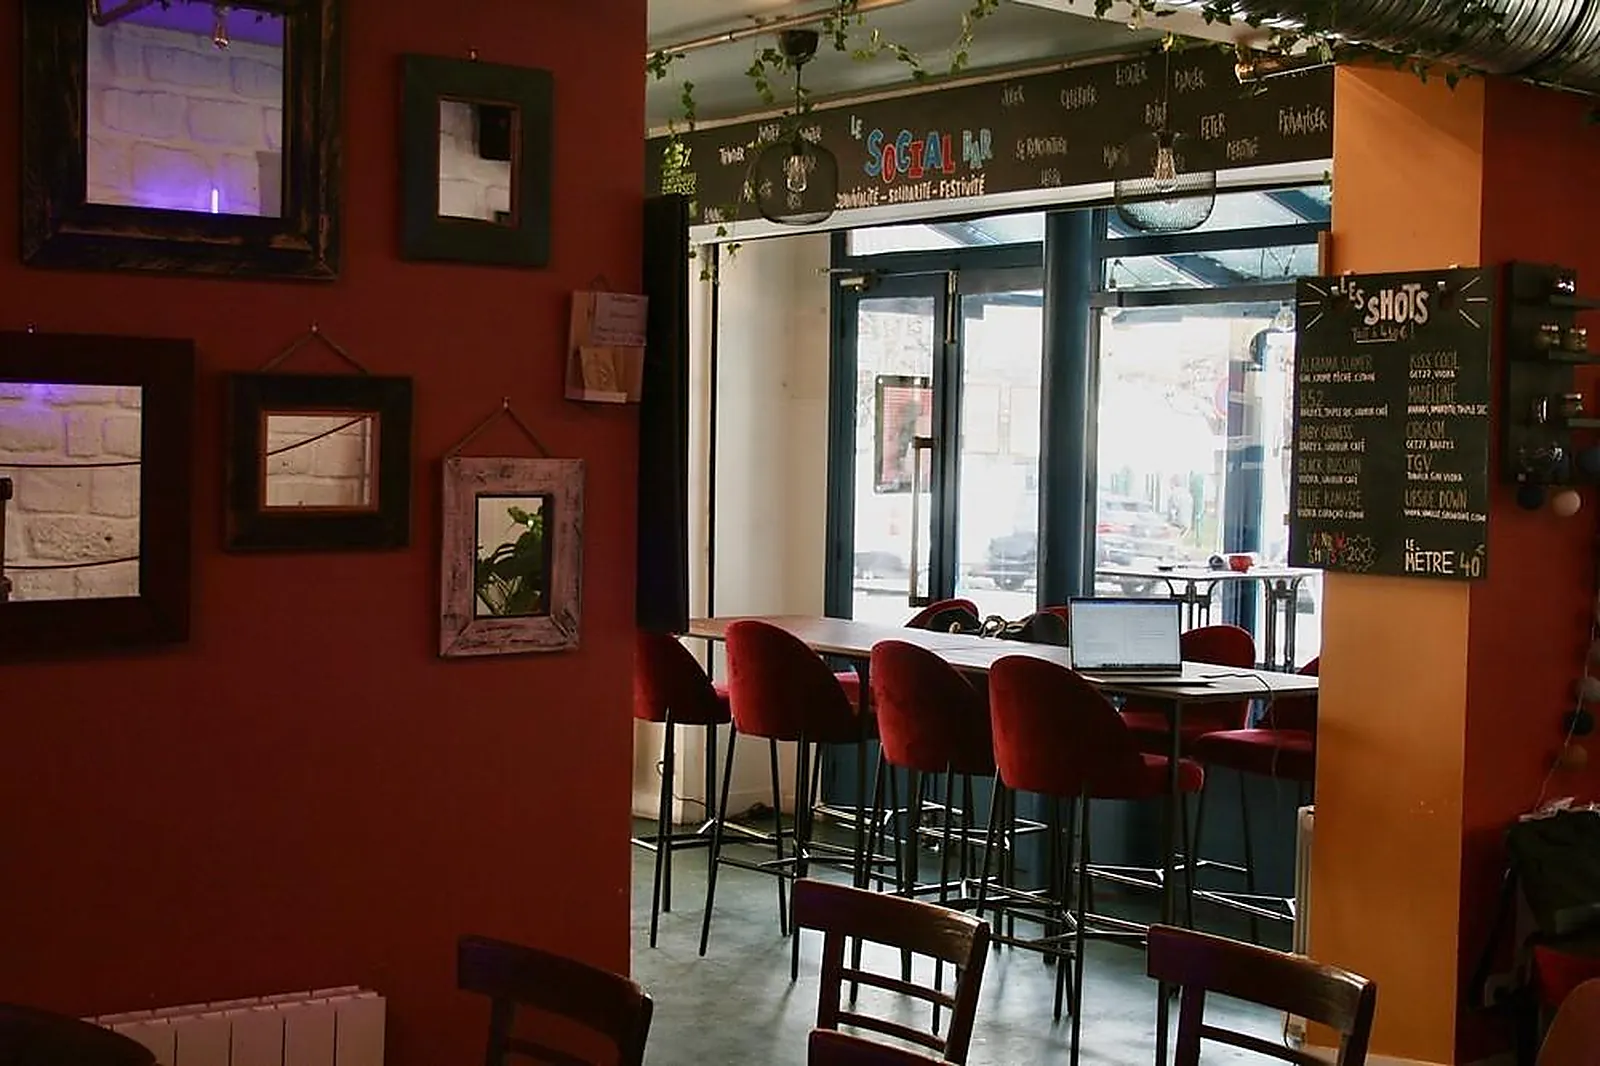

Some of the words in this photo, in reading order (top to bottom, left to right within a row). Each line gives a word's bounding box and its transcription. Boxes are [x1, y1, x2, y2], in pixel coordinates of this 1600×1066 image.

[850, 114, 862, 140] LE
[864, 128, 956, 184] SOCIAL
[962, 128, 993, 169] BAR
[939, 174, 987, 200] FESTIVITÉ
[1340, 276, 1365, 310] LES
[1364, 282, 1429, 325] SHOTS
[1406, 453, 1433, 472] TGV
[1439, 488, 1468, 511] DOWN
[1405, 538, 1415, 551] LE
